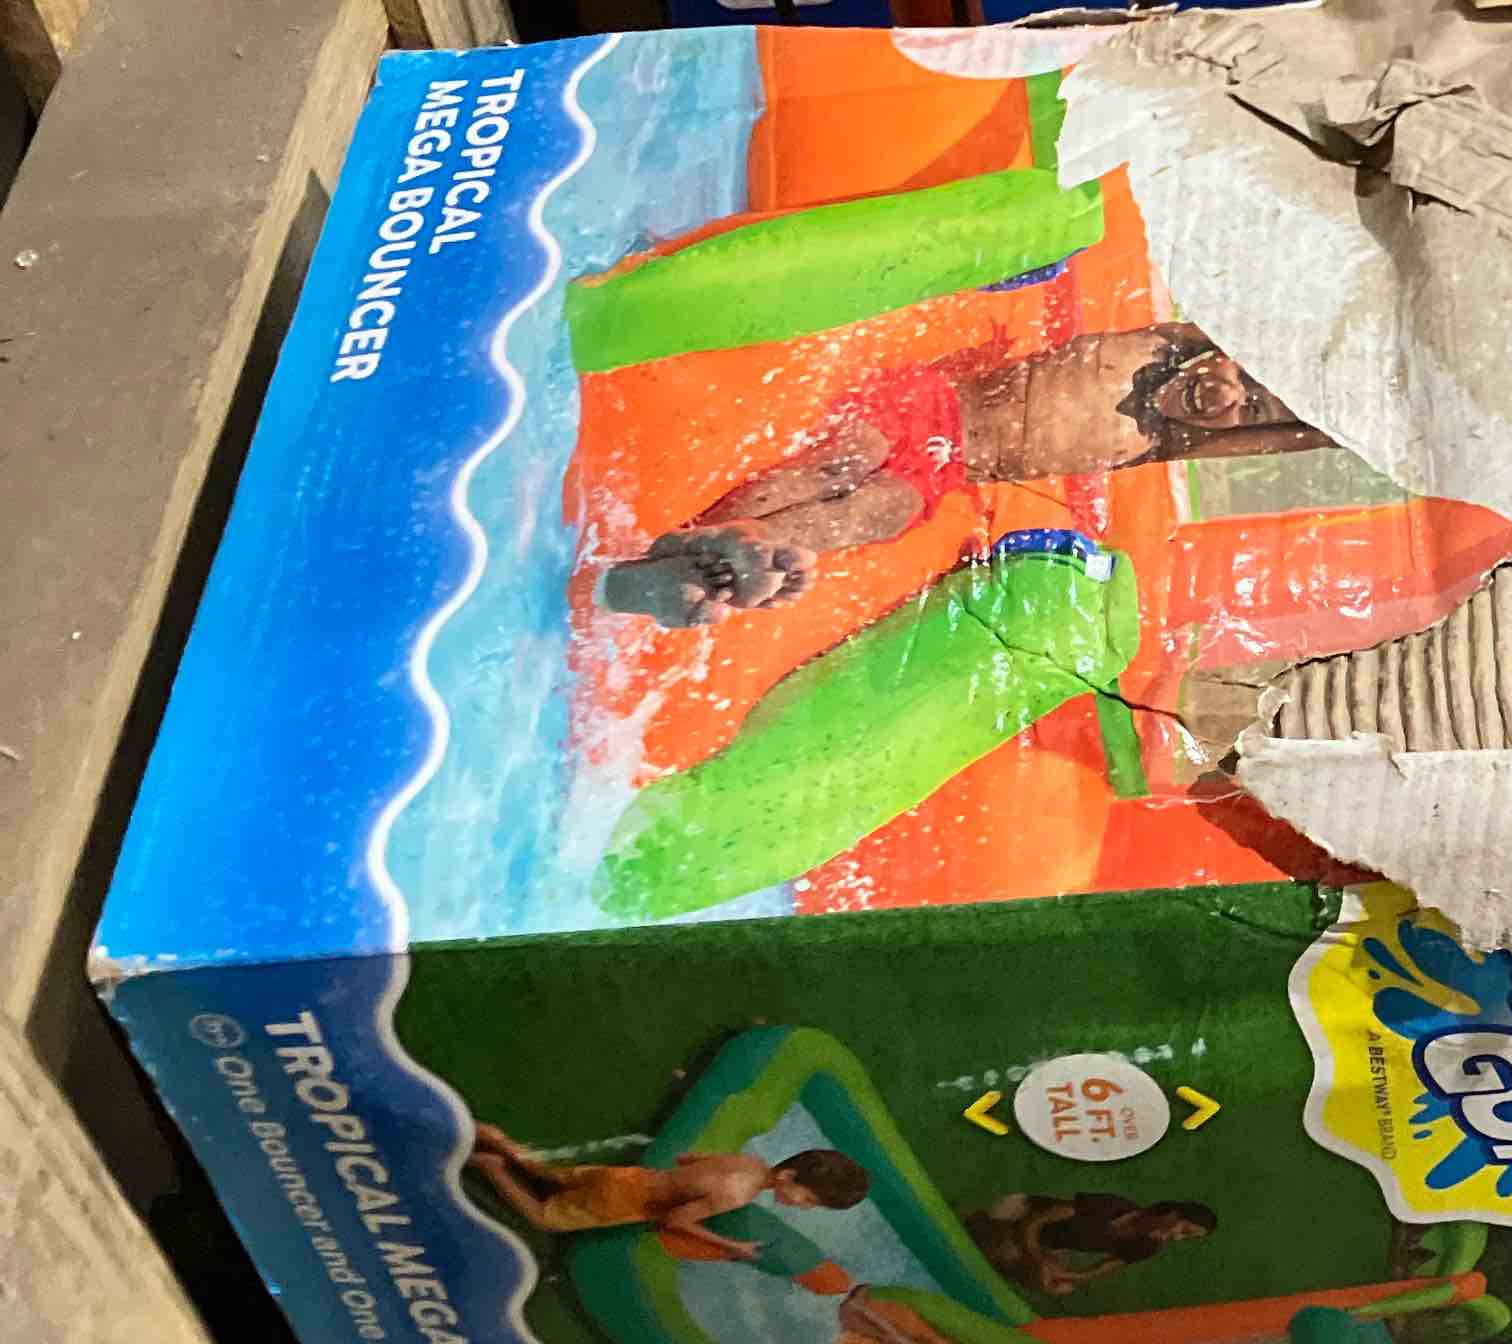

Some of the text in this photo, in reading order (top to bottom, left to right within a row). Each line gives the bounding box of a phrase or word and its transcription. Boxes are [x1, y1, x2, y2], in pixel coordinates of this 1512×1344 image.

[329, 78, 469, 384] MEGA BOUNCER
[428, 67, 526, 256] TROPICAL
[214, 1056, 266, 1116] One
[311, 1232, 367, 1290] and
[341, 1290, 386, 1341] One
[264, 1010, 411, 1235] TROPICAL
[1046, 1082, 1081, 1144] TALL
[1080, 1077, 1126, 1144] 6 FT.
[1377, 1117, 1397, 1161] BRAND
